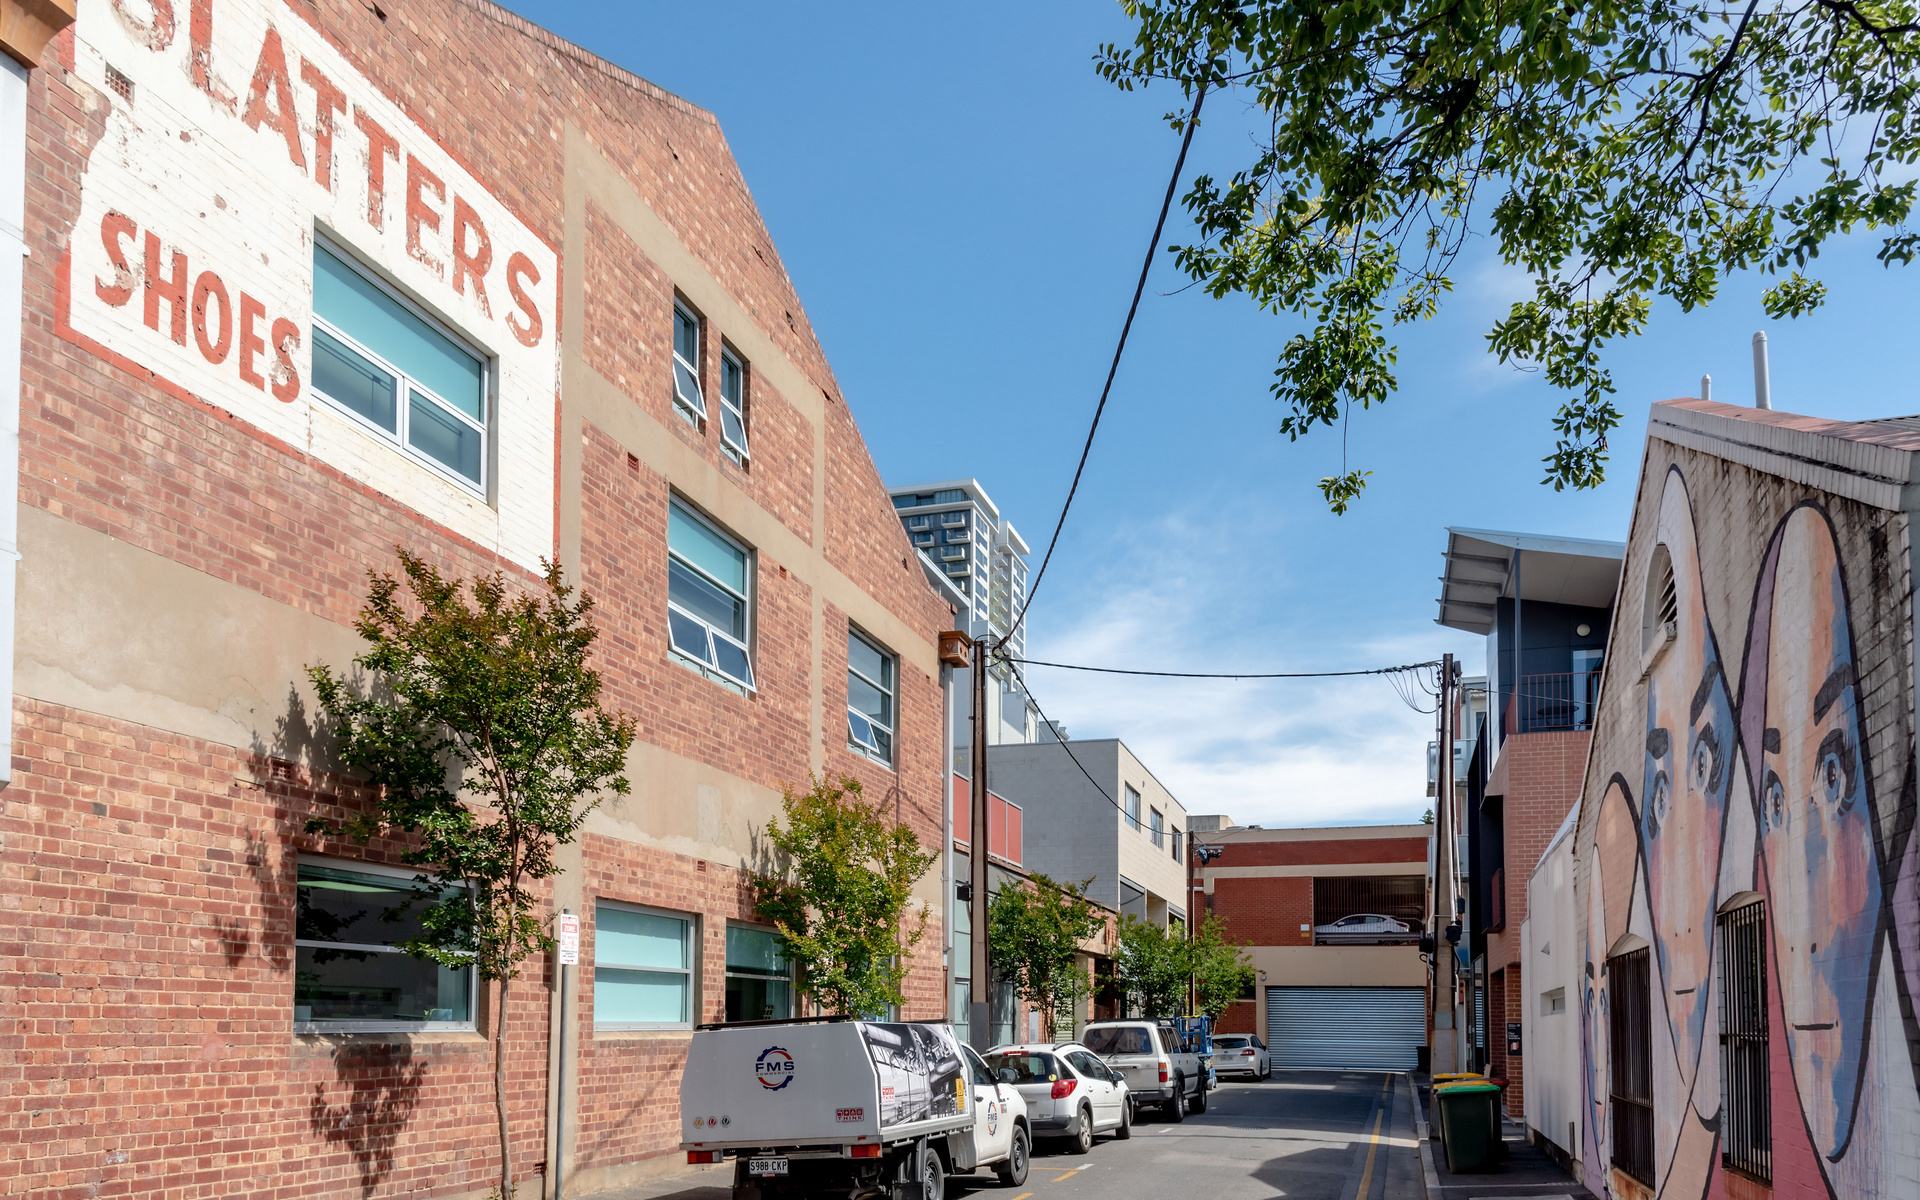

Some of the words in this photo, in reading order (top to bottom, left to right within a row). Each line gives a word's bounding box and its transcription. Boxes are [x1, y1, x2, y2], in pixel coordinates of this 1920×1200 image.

[95, 208, 301, 403] SHOES
[755, 1061, 795, 1072] FMS
[988, 1112, 997, 1121] FMS
